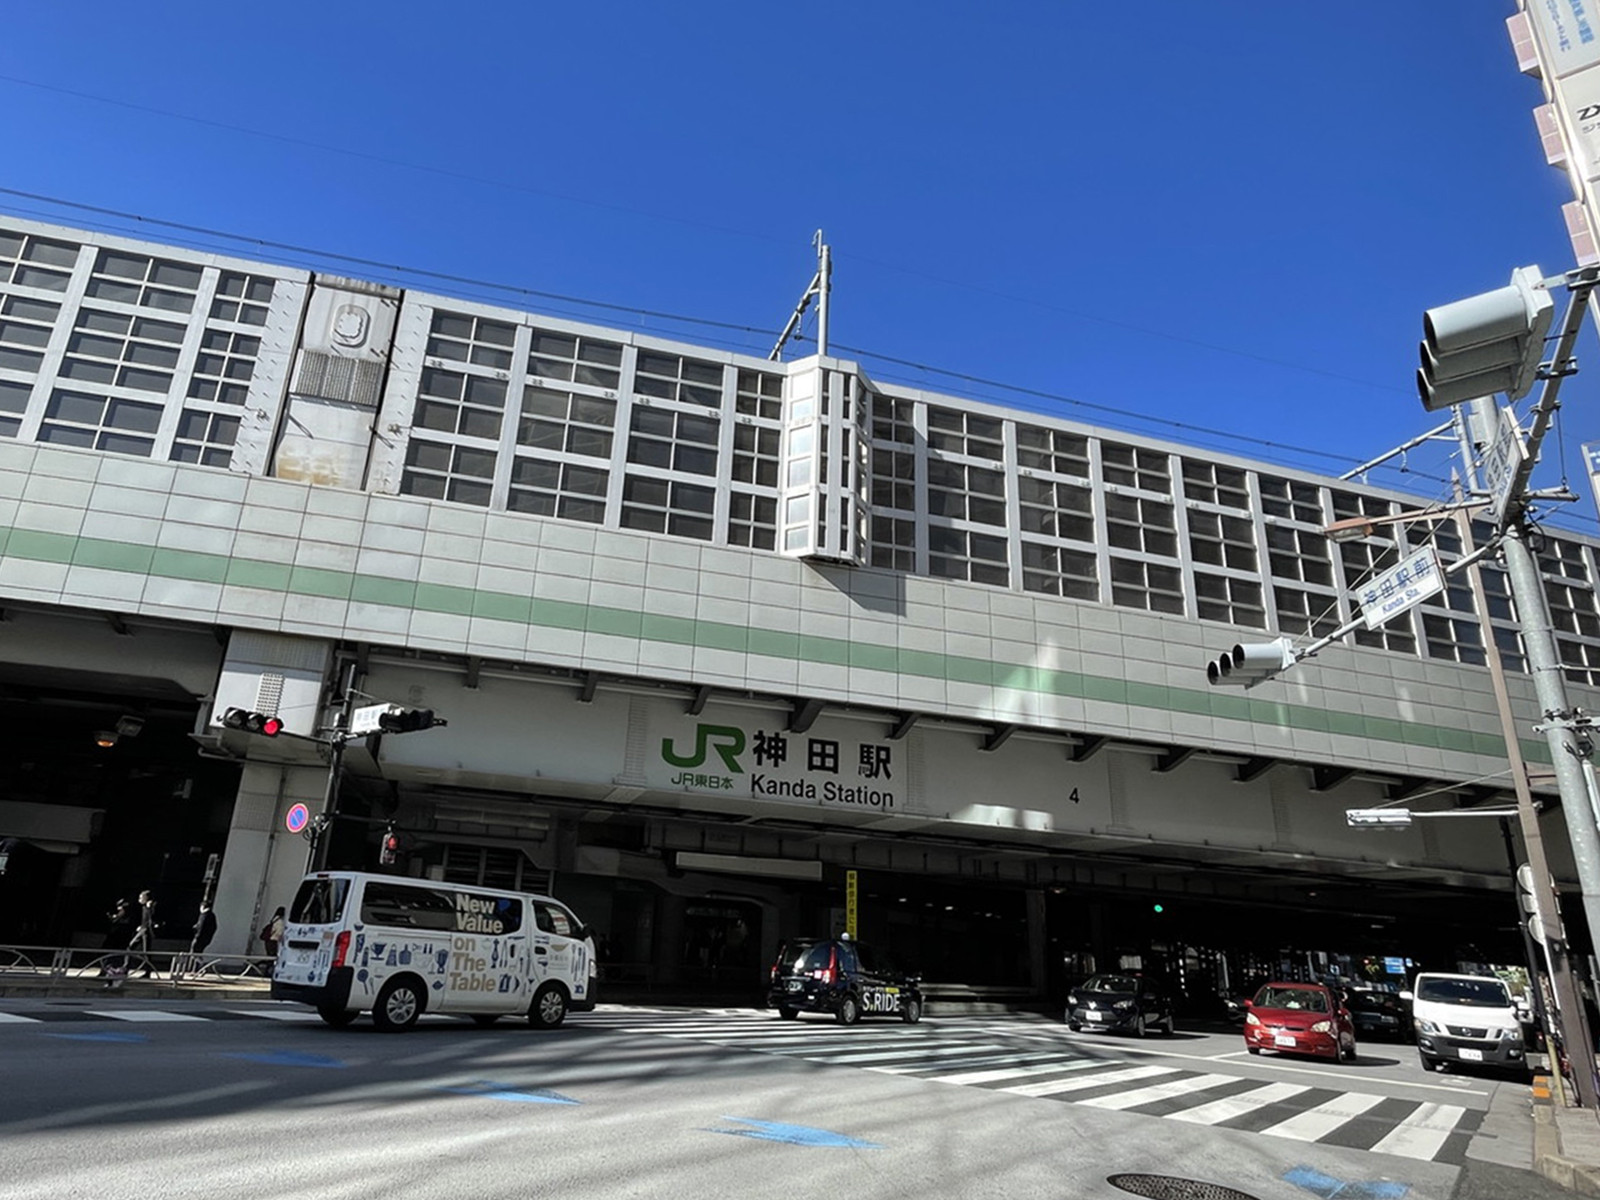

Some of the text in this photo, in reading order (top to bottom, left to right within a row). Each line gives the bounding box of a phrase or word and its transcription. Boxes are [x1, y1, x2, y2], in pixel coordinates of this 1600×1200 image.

[1382, 596, 1405, 614] Kanda
[661, 723, 746, 774] JR
[752, 730, 892, 780] 神田駅
[671, 772, 734, 790] JR東日本
[751, 774, 894, 807] Kanda Station
[1069, 787, 1080, 804] 4
[455, 894, 496, 914] New
[456, 912, 503, 934] Value
[453, 936, 476, 951] on
[452, 952, 486, 972] The
[449, 972, 497, 992] Table
[862, 992, 901, 1012] S.RIDE
